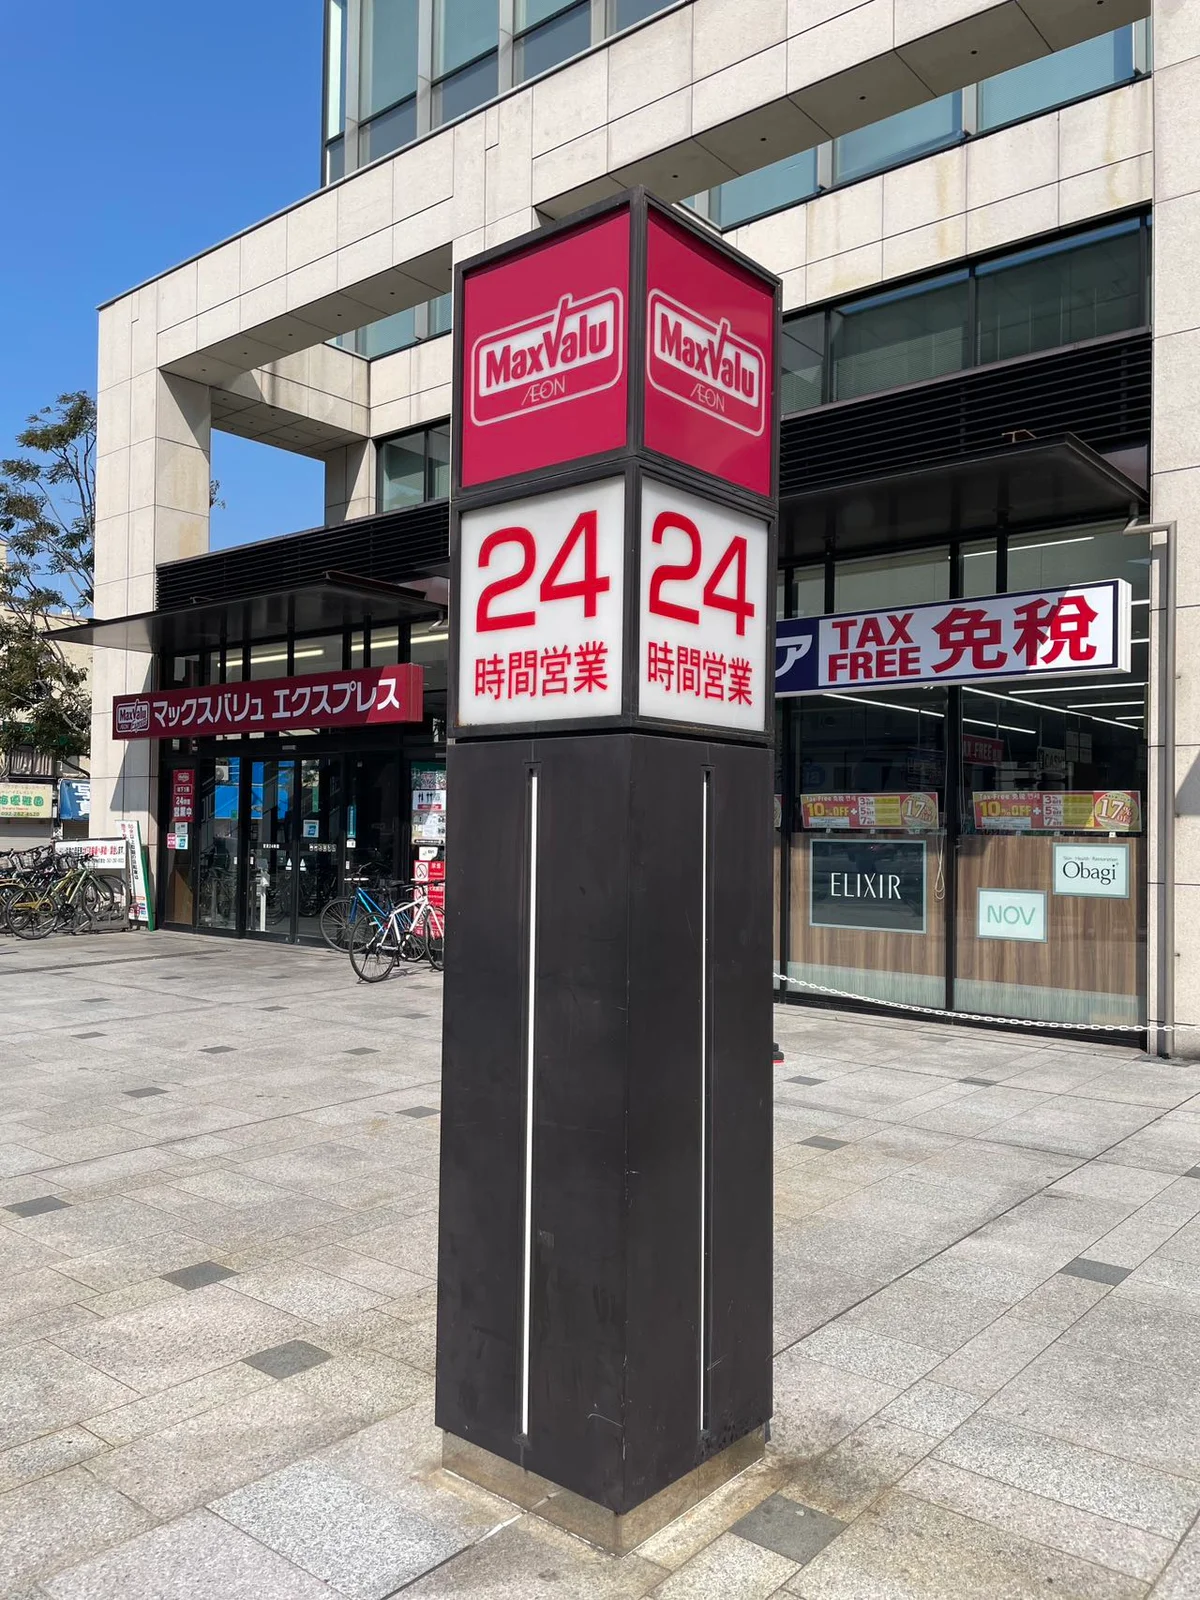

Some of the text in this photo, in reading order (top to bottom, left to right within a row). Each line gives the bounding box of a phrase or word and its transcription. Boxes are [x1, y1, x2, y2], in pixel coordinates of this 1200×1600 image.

[485, 298, 607, 389] MaxValu
[660, 312, 755, 398] MaxValu
[475, 510, 610, 633] 24
[648, 511, 755, 636] 24
[831, 612, 914, 650] TAX
[930, 594, 1099, 674] 免税
[474, 640, 609, 700] 時間営業
[646, 640, 754, 706] 時間営業
[828, 646, 921, 682] FREE
[153, 678, 400, 728] マックスバリュ エクスプレス
[831, 872, 901, 899] ELIXIR
[1062, 861, 1116, 885] Obagi
[987, 905, 1036, 925] NOV
